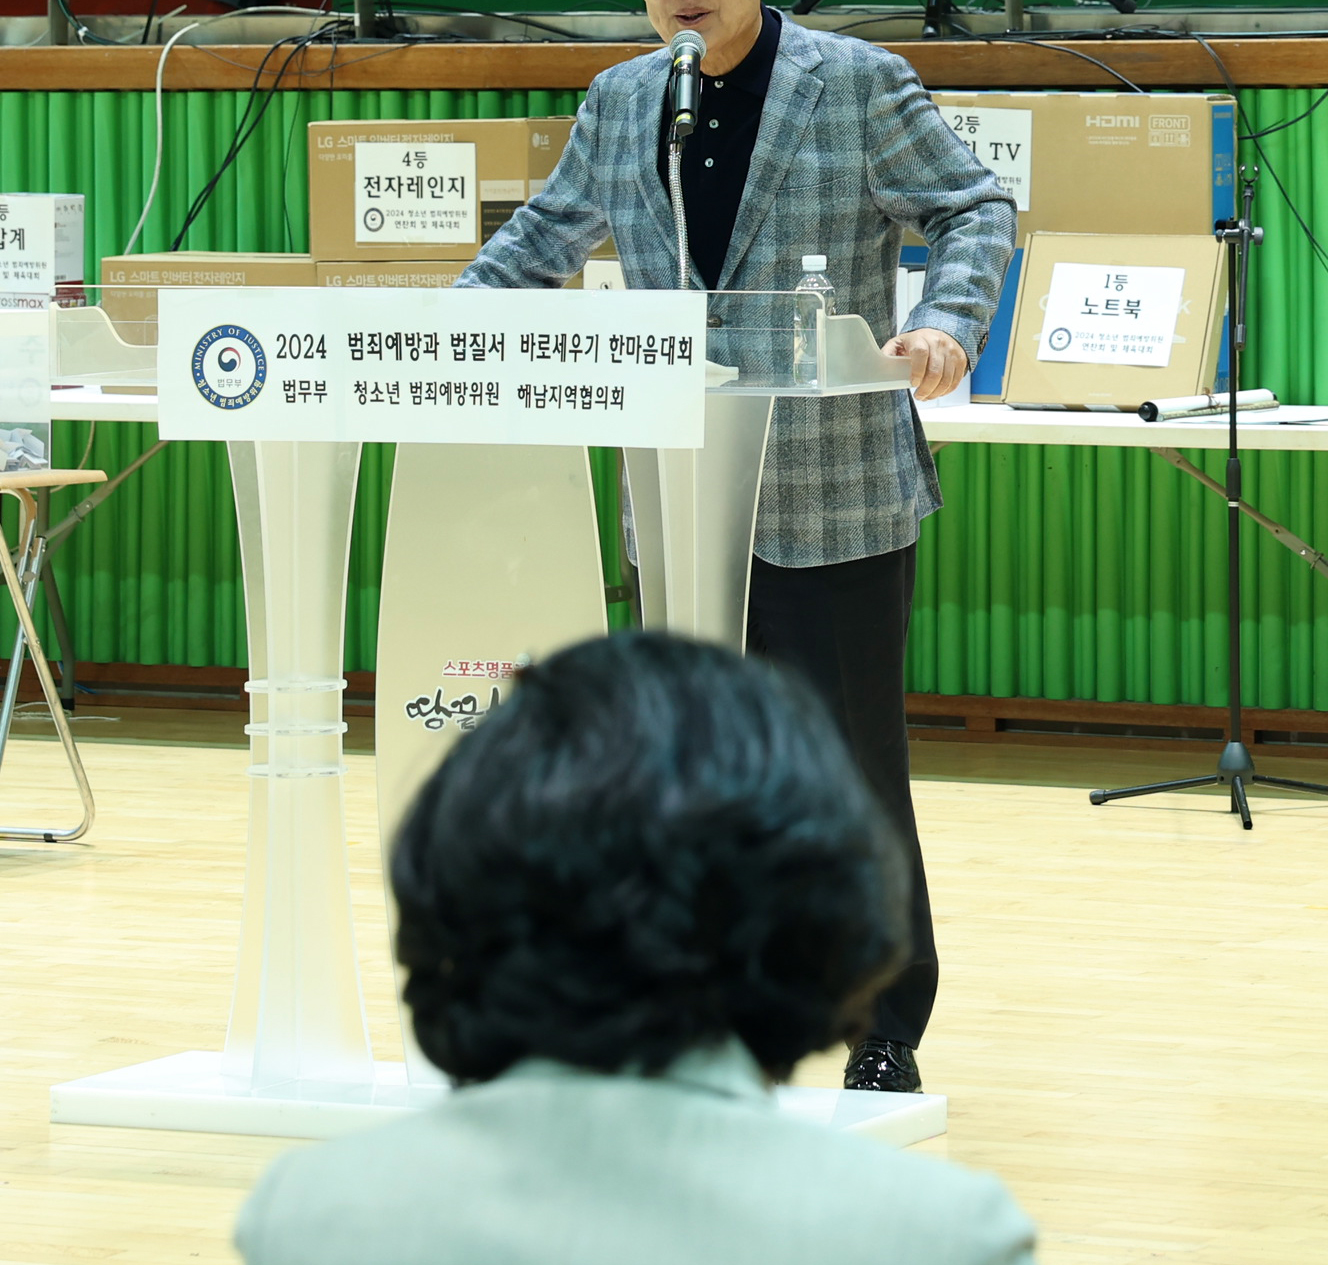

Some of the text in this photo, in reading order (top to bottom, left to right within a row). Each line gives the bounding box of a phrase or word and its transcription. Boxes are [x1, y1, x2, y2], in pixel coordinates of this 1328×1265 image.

[953, 114, 980, 134] 2등
[1085, 115, 1140, 128] HDMI
[1152, 117, 1187, 129] FRONT
[317, 136, 333, 148] LG
[539, 134, 550, 145] LG
[989, 142, 1021, 161] TV
[402, 151, 428, 169] 4등
[363, 175, 466, 199] 전자레인지
[386, 209, 405, 217] 2024
[408, 209, 427, 218] 청소년
[420, 221, 428, 229] 및
[431, 220, 460, 229] 체육대회
[110, 271, 246, 285] LG 스마트 인버터 전자레인지
[326, 276, 342, 287] LG
[346, 274, 375, 286] 스마트
[1104, 274, 1128, 292] 1등
[1080, 297, 1142, 319] 노트북
[1074, 331, 1094, 339] 2024
[1099, 332, 1120, 342] 청소년
[194, 327, 265, 371] MINISTRY OF JUSTICE
[276, 332, 693, 366] 2024 범죄예방과 법질서 바로세우기 한마음대회
[1110, 344, 1117, 352] 및
[1122, 344, 1153, 354] 체육대회
[217, 378, 242, 388] 법무부
[282, 379, 625, 410] 법무부 청소년 범죄예방위원 해남지역협의회
